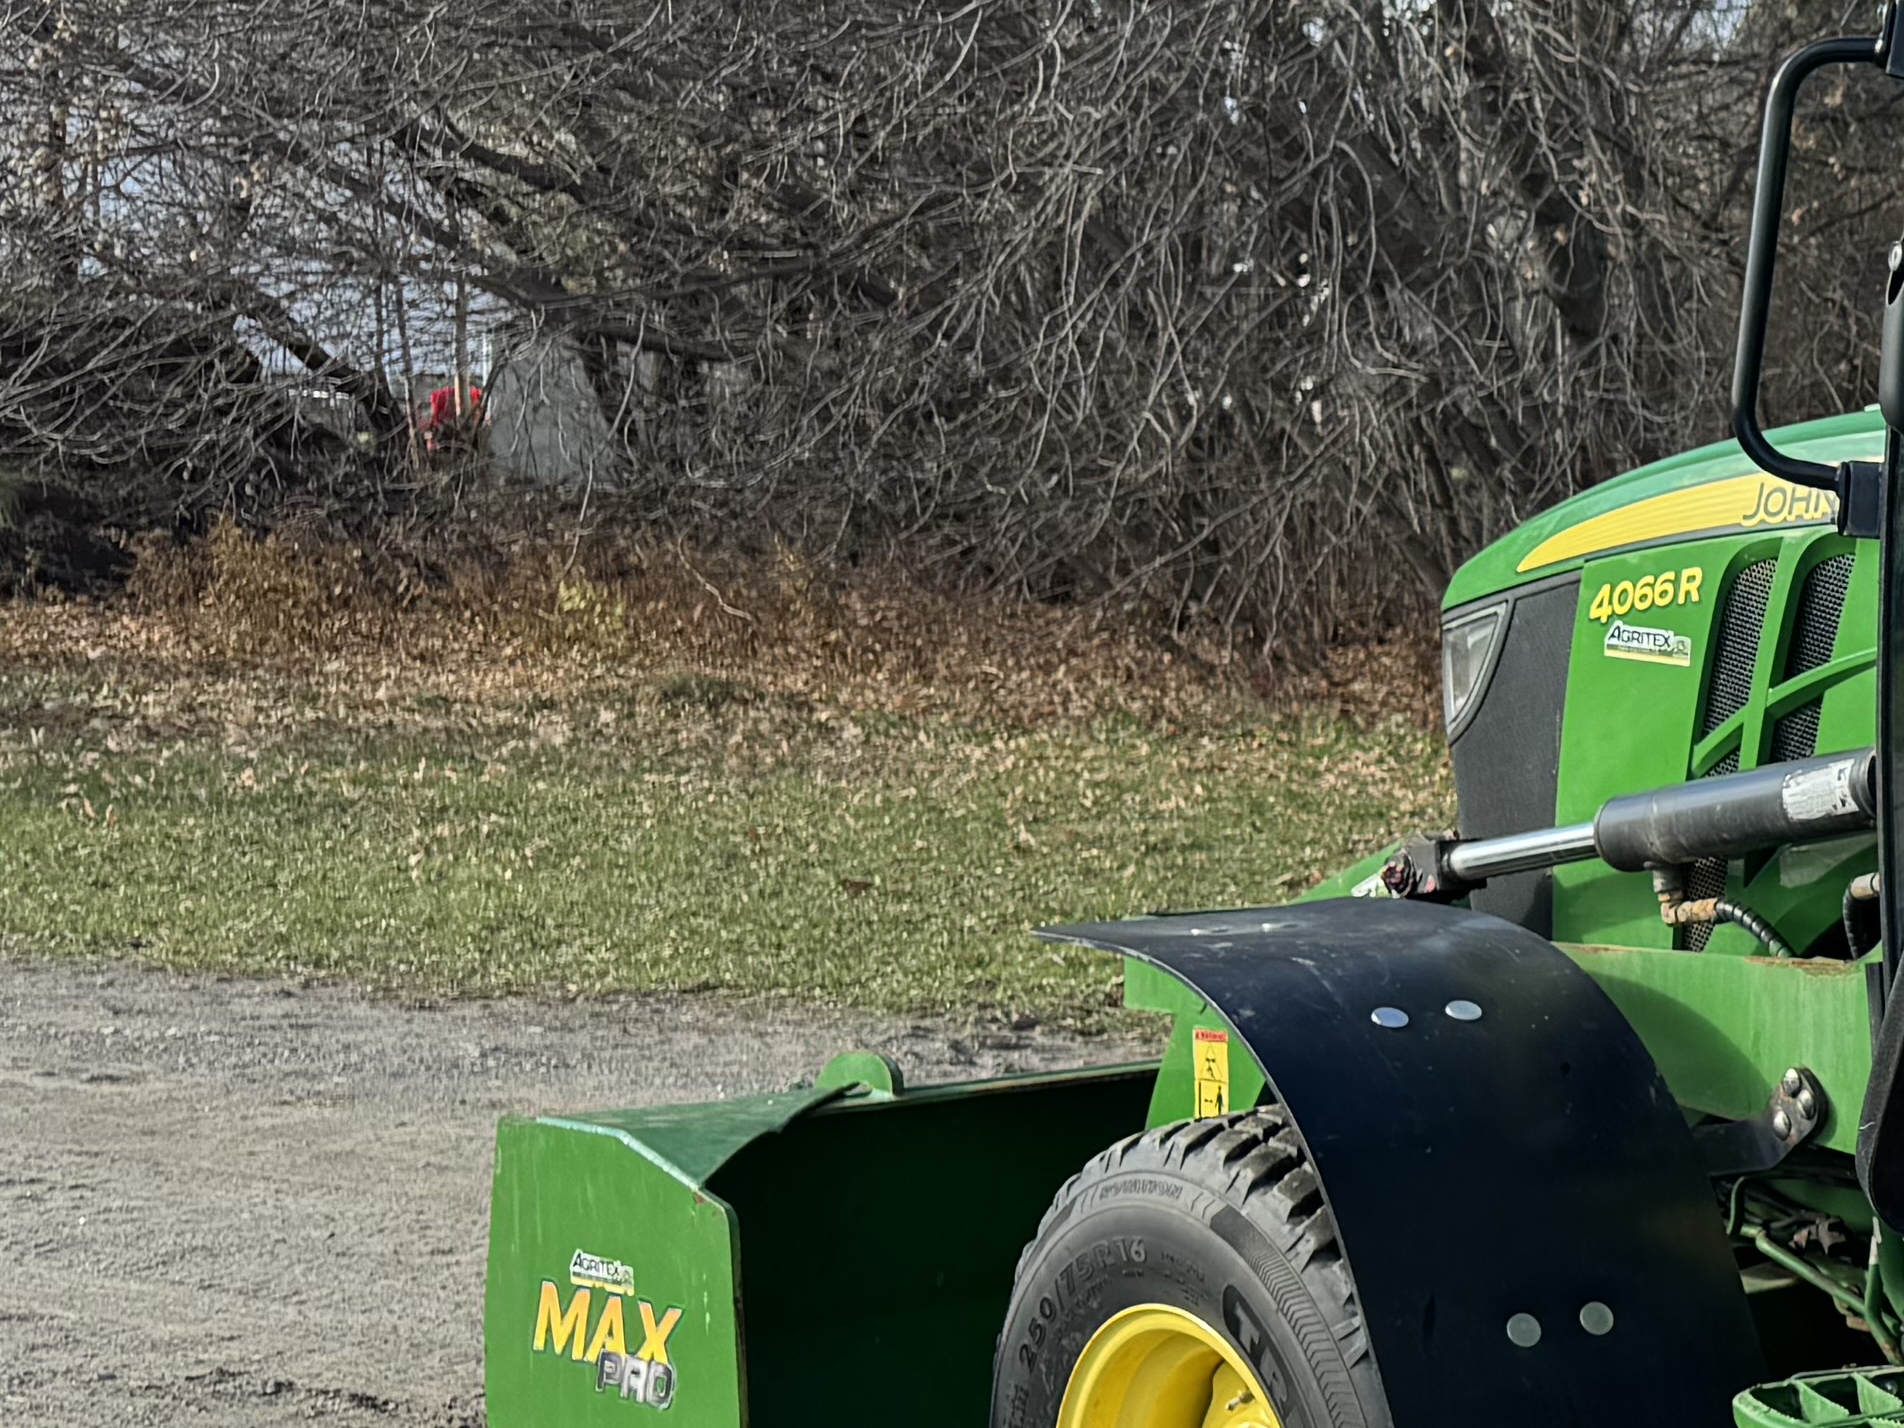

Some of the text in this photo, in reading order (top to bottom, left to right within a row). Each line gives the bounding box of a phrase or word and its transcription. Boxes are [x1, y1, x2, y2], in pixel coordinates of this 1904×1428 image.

[1589, 566, 1703, 624] 4066R
[532, 1280, 683, 1364] MAX
[595, 1348, 677, 1411] PRO
